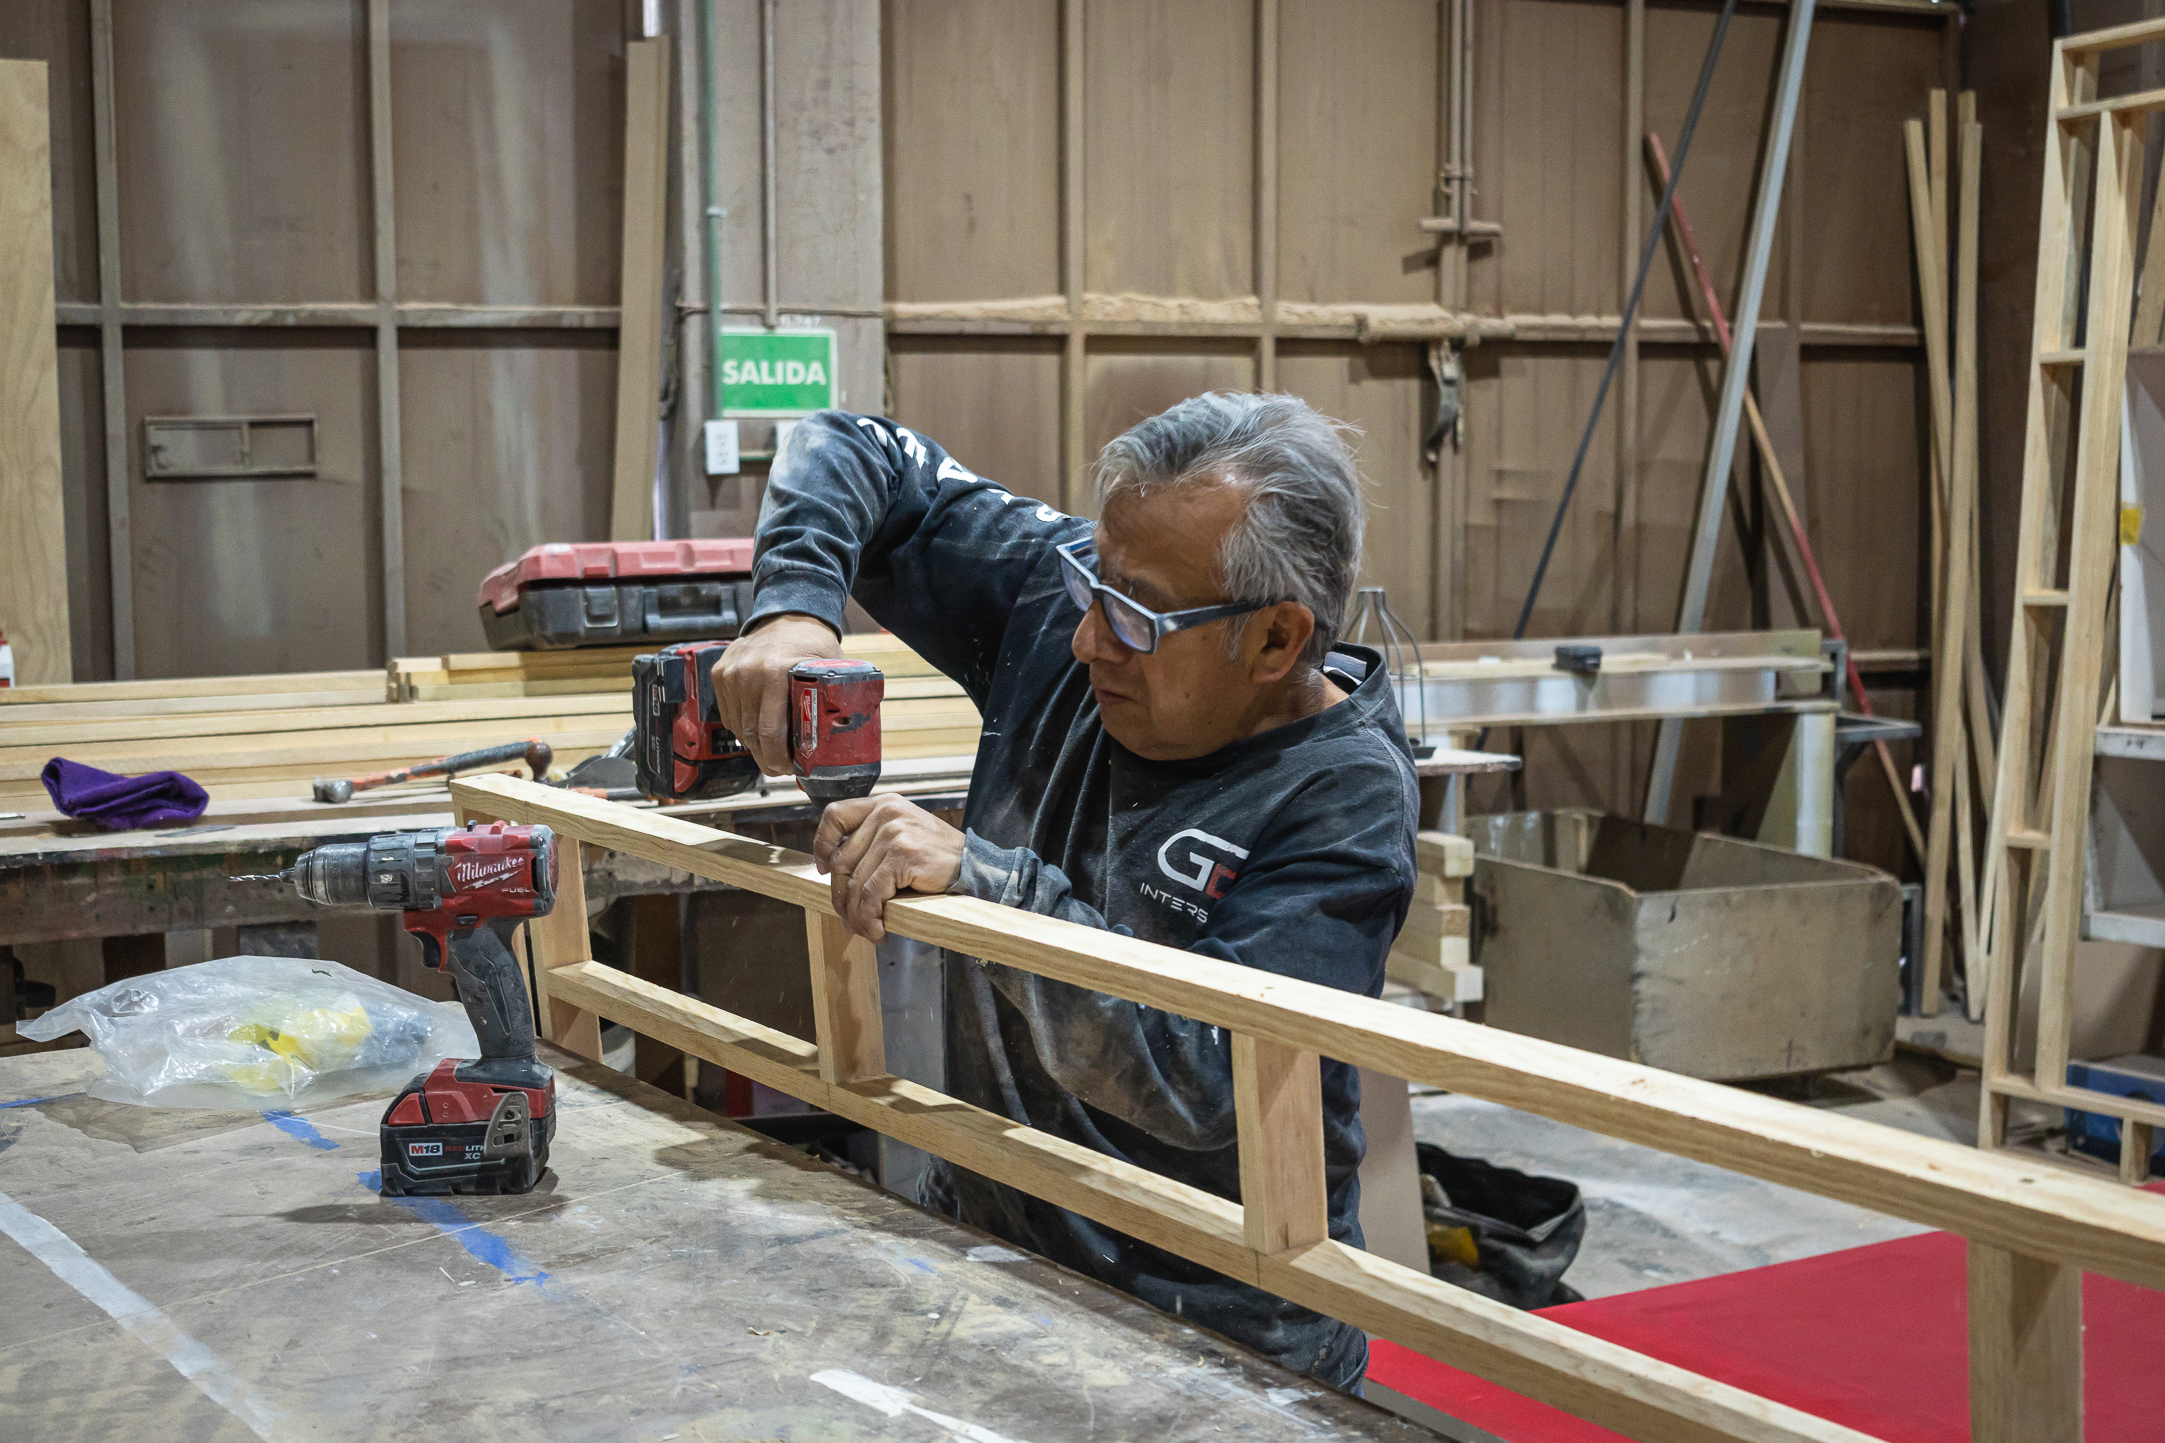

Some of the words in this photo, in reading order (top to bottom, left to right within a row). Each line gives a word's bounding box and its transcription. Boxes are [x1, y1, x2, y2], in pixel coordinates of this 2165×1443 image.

[722, 358, 827, 386] SALIDA
[454, 856, 525, 882] Milwaukee
[501, 886, 531, 894] FUEL
[1139, 882, 1209, 924] INTERS
[410, 1144, 441, 1155] M18
[464, 1152, 481, 1160] XC
